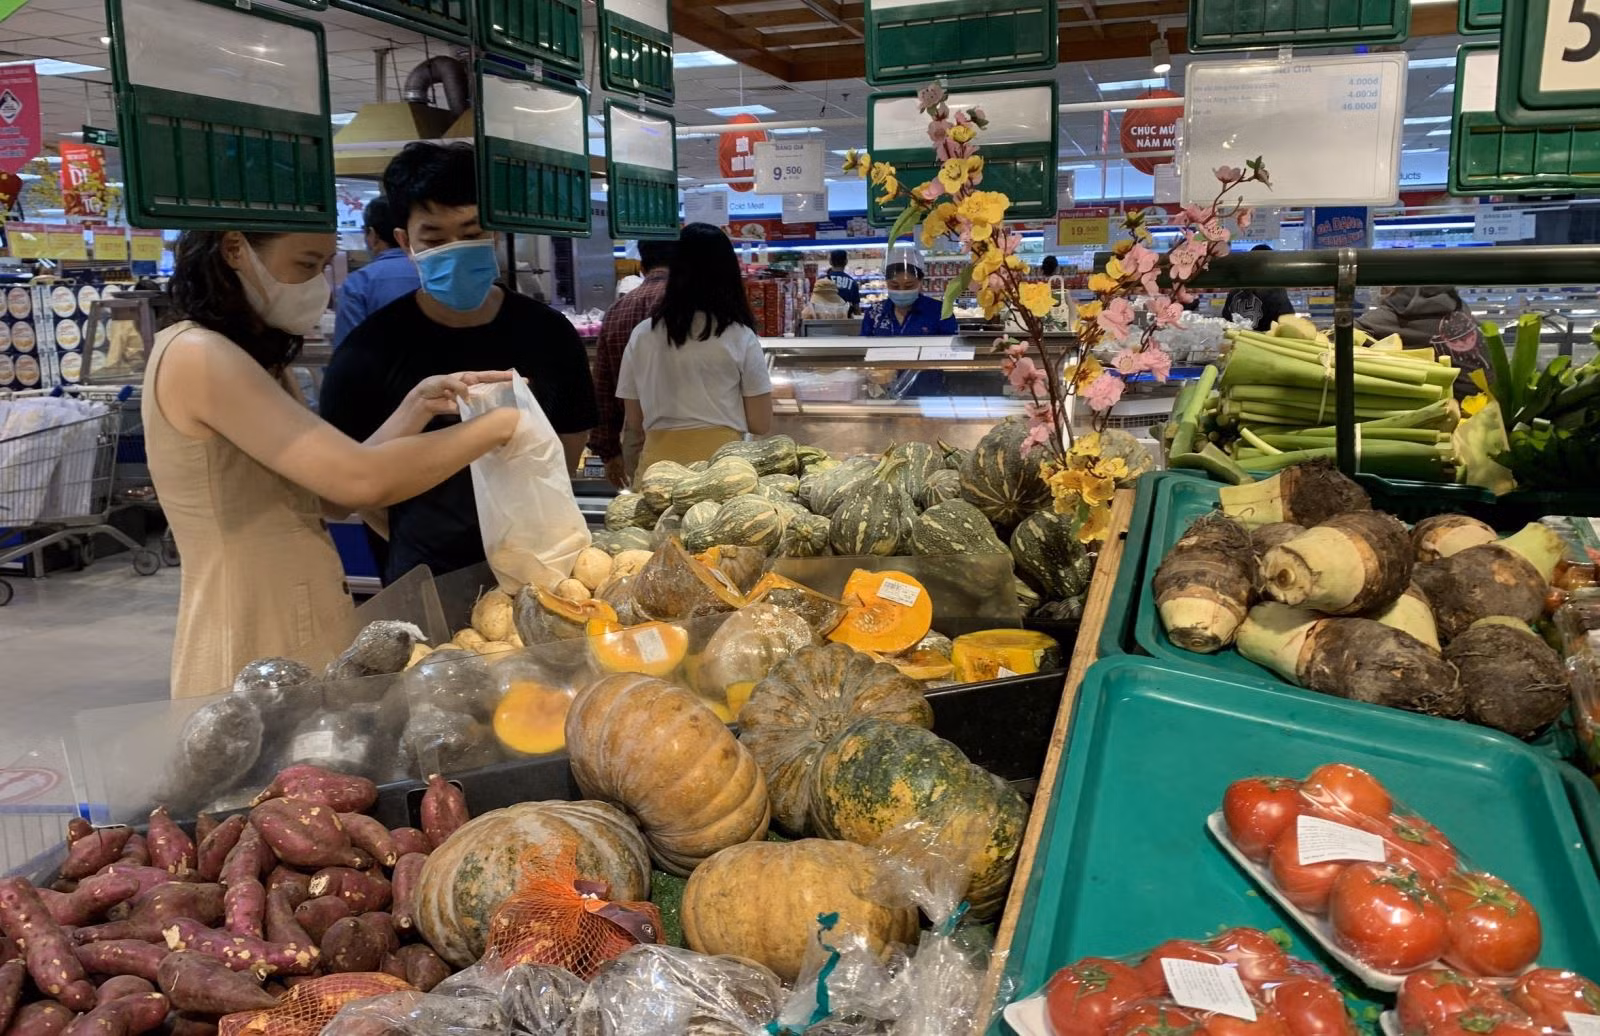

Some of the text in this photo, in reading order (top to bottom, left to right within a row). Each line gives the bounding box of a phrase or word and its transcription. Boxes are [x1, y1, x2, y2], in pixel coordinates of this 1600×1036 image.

[1130, 124, 1157, 136] CHÚC
[1136, 136, 1161, 148] NĂM
[729, 202, 746, 210] Cold
[747, 202, 765, 210] Meat
